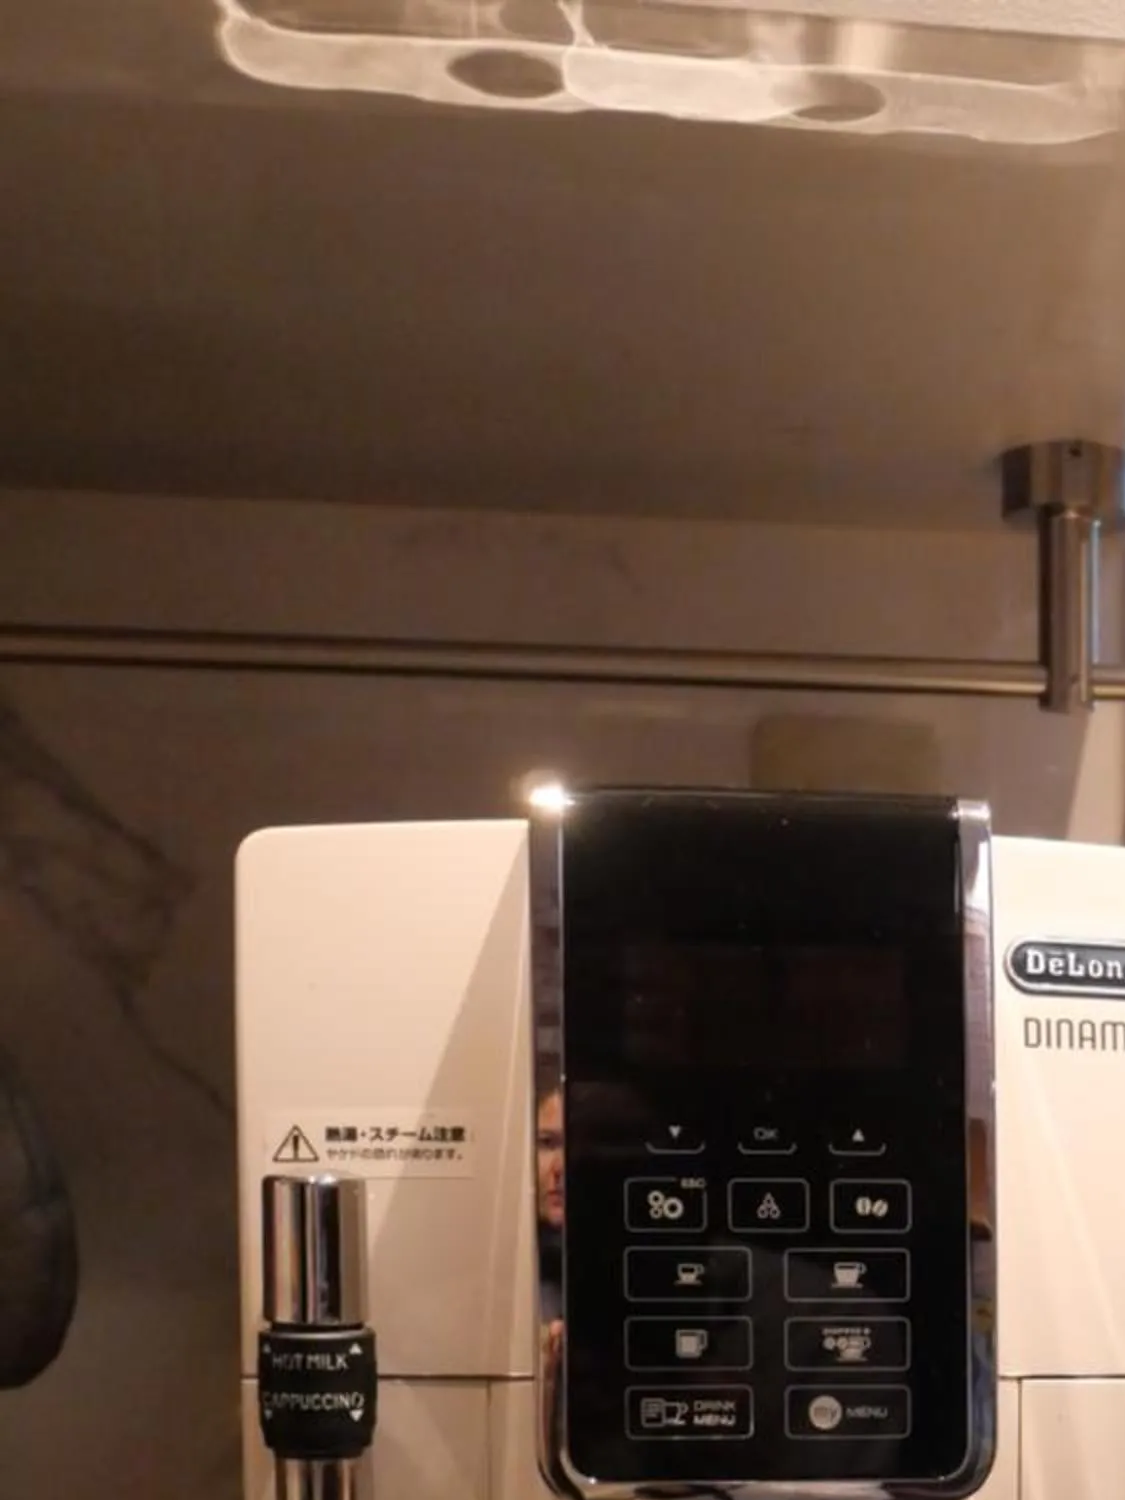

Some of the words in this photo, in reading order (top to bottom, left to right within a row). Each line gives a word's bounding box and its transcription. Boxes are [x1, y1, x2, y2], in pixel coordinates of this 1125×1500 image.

[754, 1128, 778, 1141] OK
[271, 1353, 303, 1370] HOT
[305, 1353, 349, 1371] MILK
[694, 1401, 736, 1412] DRINK
[847, 1406, 888, 1419] MENU
[693, 1413, 736, 1426] MENU
